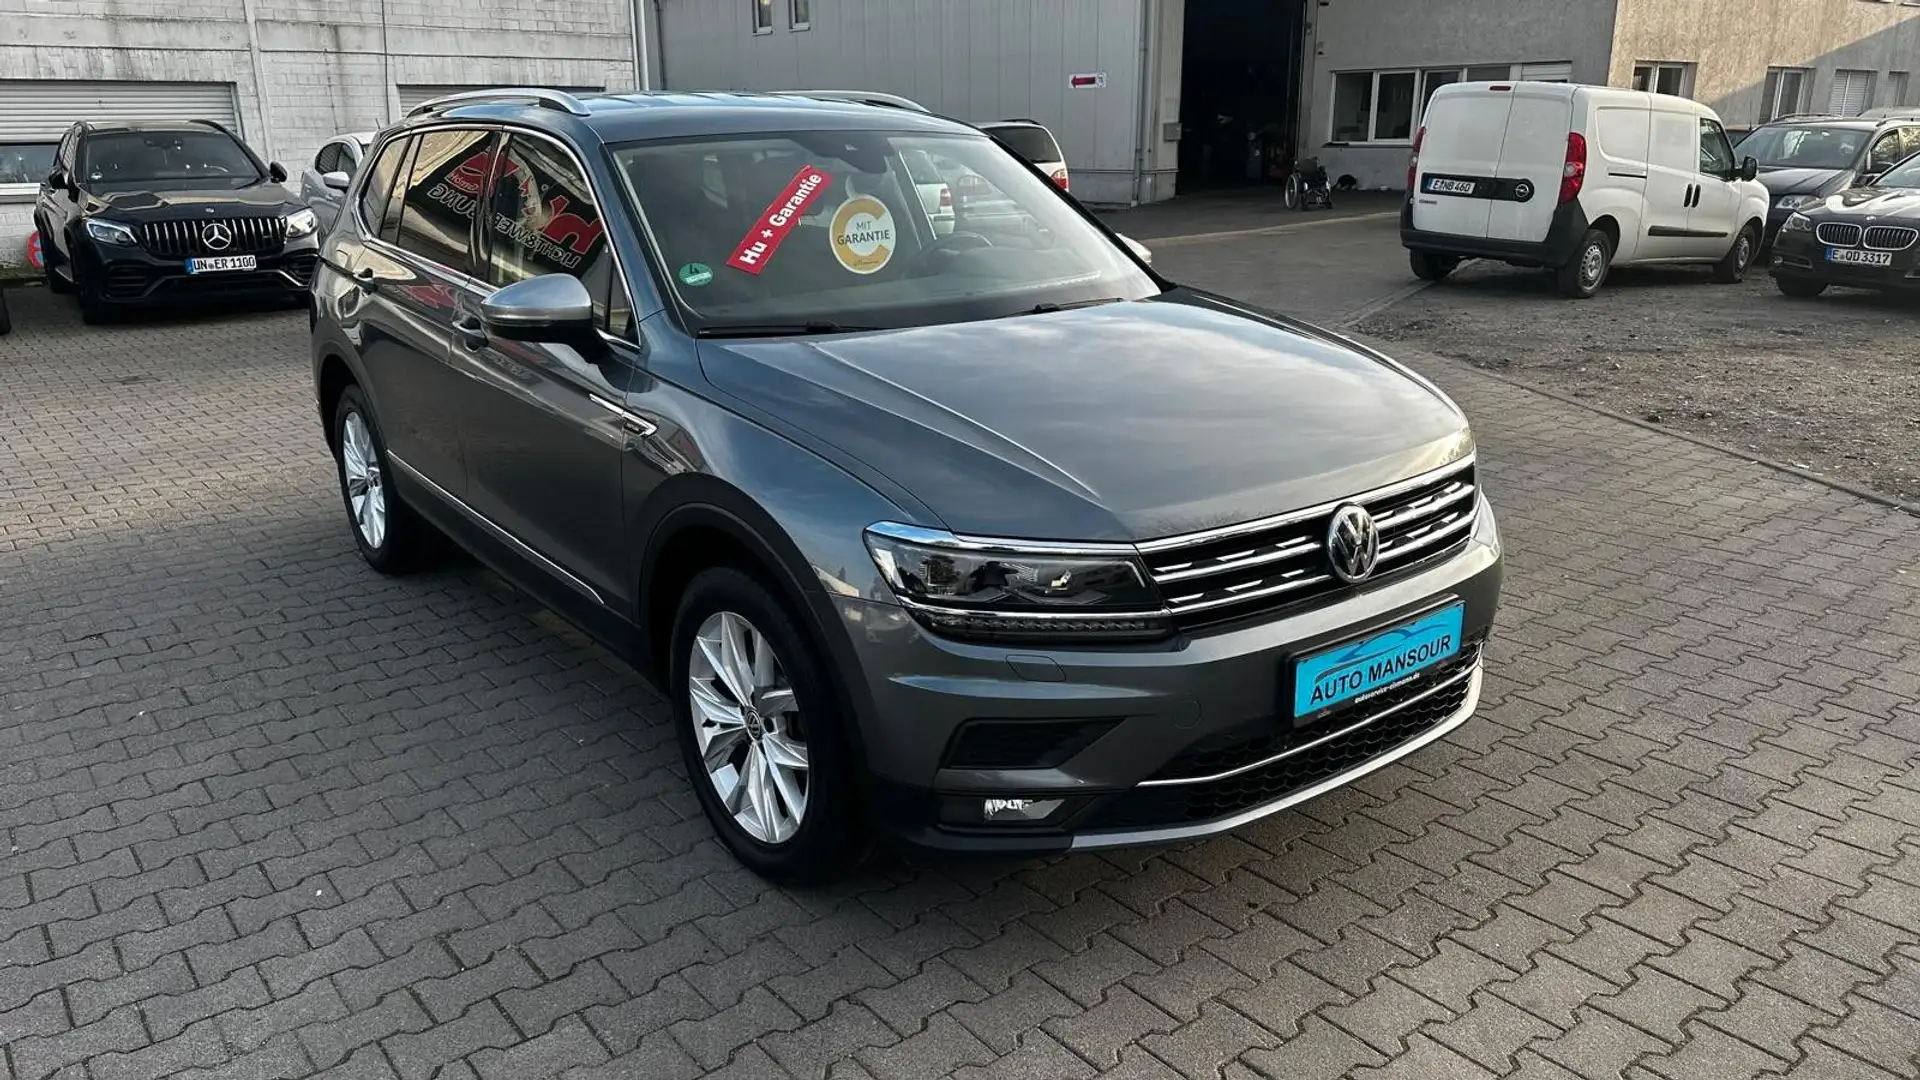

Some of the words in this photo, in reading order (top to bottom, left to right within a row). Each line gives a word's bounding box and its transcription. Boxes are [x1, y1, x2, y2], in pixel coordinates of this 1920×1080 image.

[739, 241, 768, 265] Hu
[768, 173, 822, 227] Garantie
[856, 221, 872, 231] MIT
[837, 230, 890, 245] GARANTIE
[193, 259, 208, 270] UN
[214, 258, 229, 269] ER
[230, 256, 256, 268] 1100
[1832, 249, 1840, 260] E
[1861, 252, 1890, 264] 3317
[689, 263, 700, 275] 4
[1309, 670, 1363, 706] AUTO
[1367, 634, 1451, 684] MANSOUR
